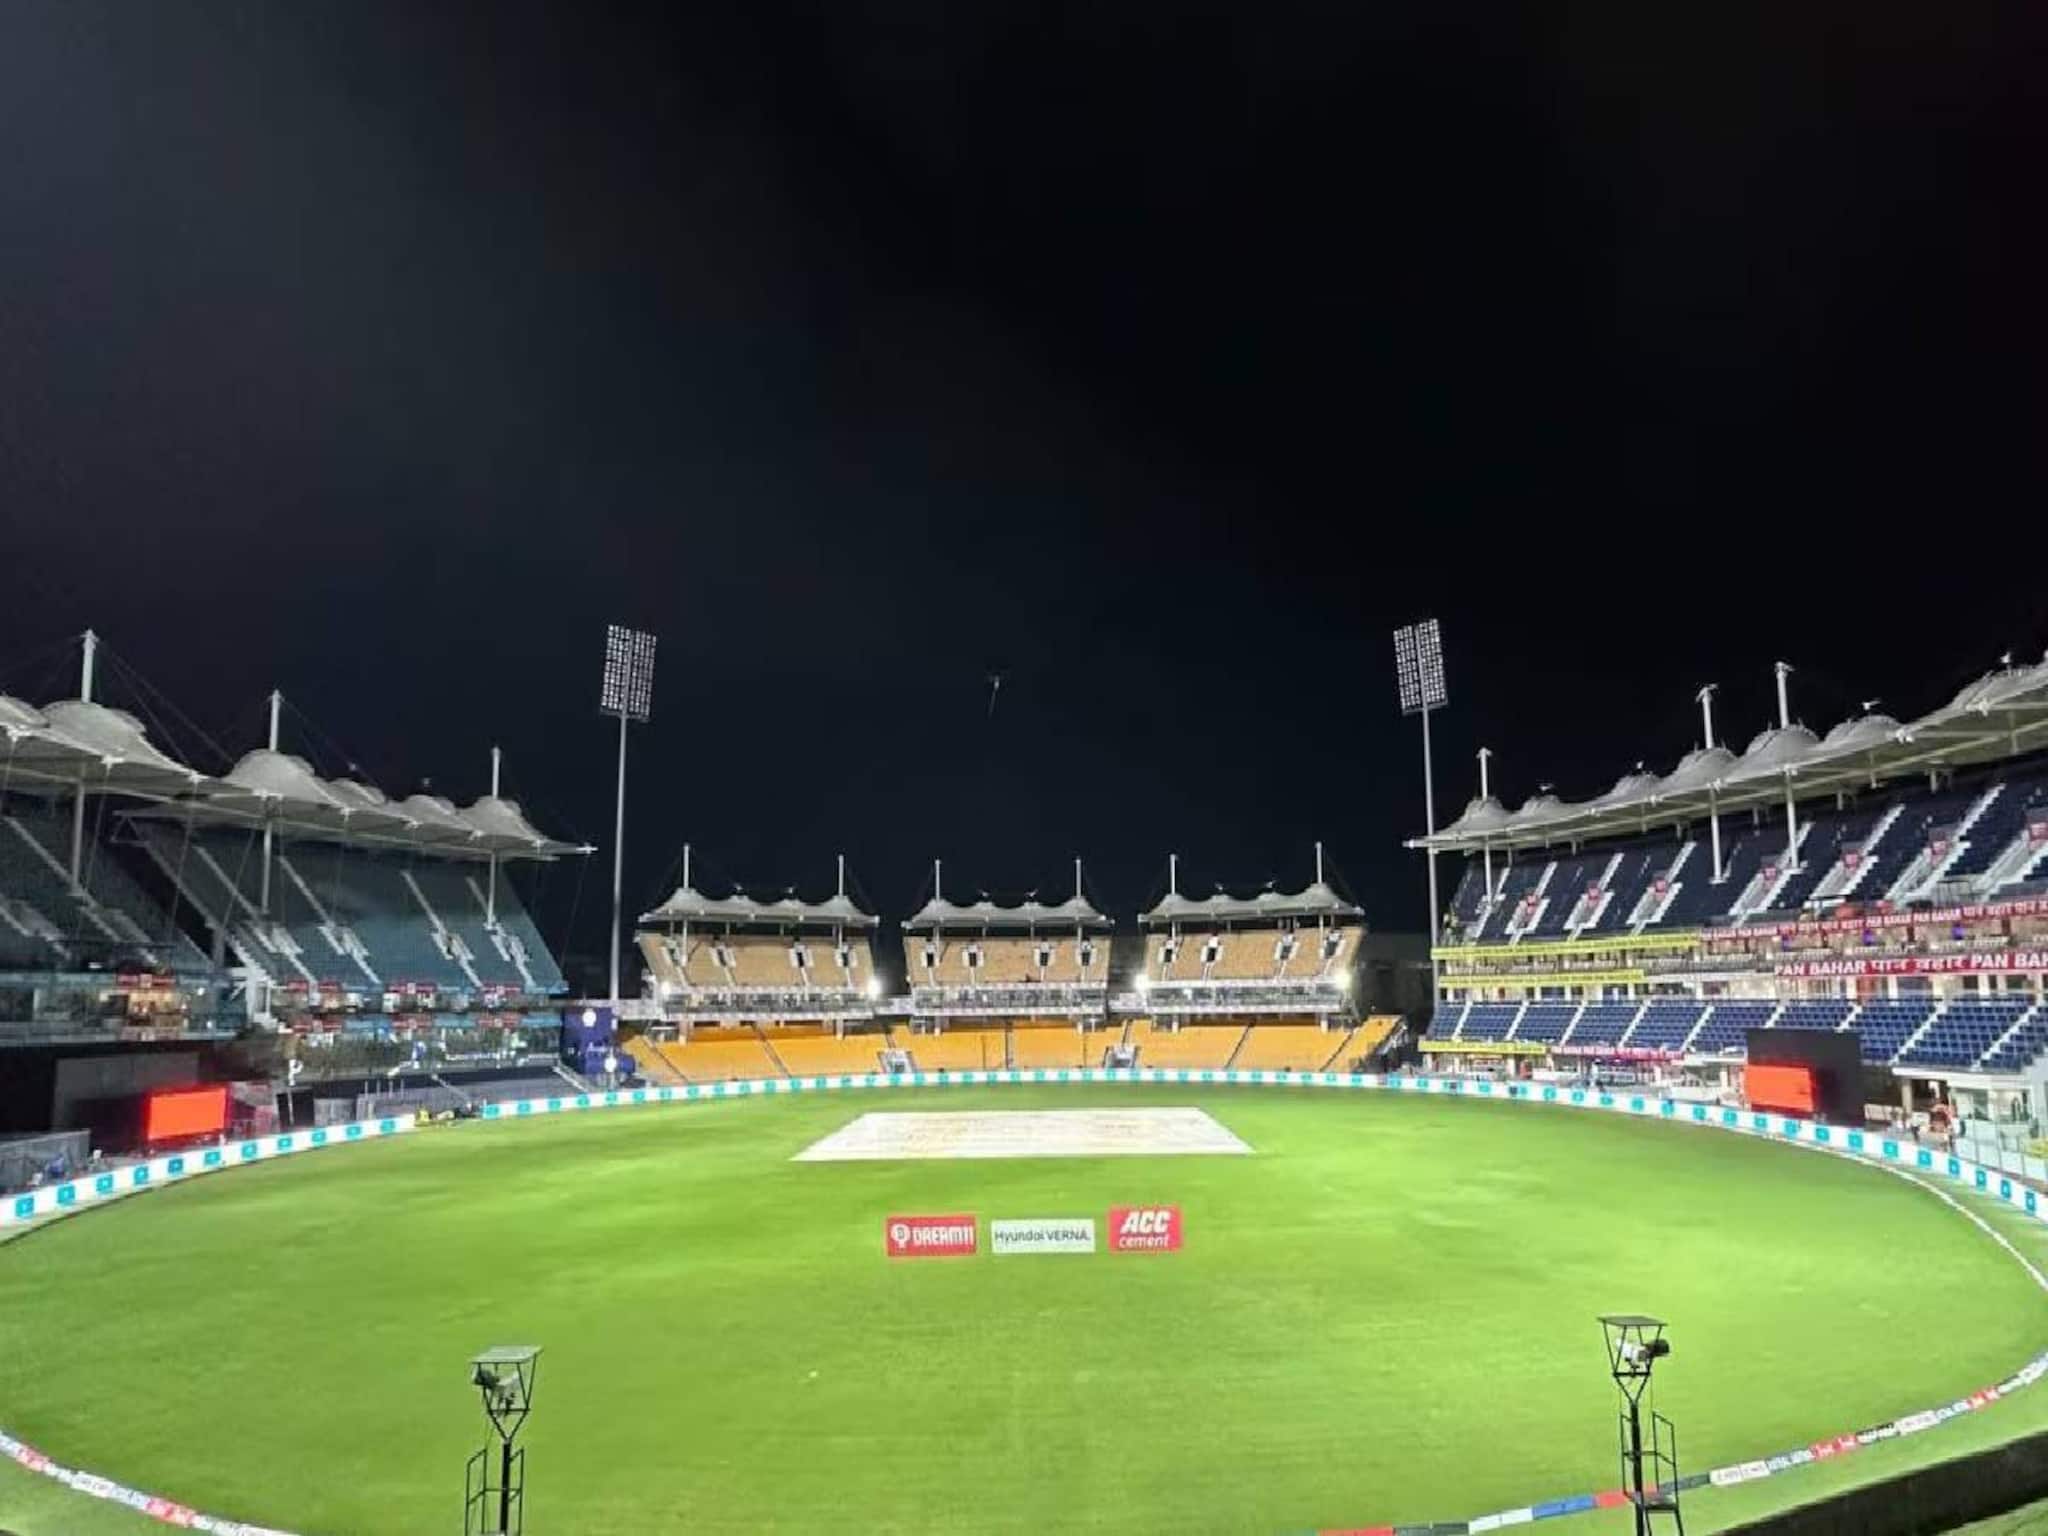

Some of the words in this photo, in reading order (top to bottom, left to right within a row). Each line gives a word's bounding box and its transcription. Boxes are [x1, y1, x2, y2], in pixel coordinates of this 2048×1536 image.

[1775, 963, 1805, 976] PAN
[1809, 960, 1867, 974] BAHAR
[1971, 952, 2009, 968] PAN
[1120, 1210, 1171, 1234] ACC
[1119, 1234, 1169, 1248] cement
